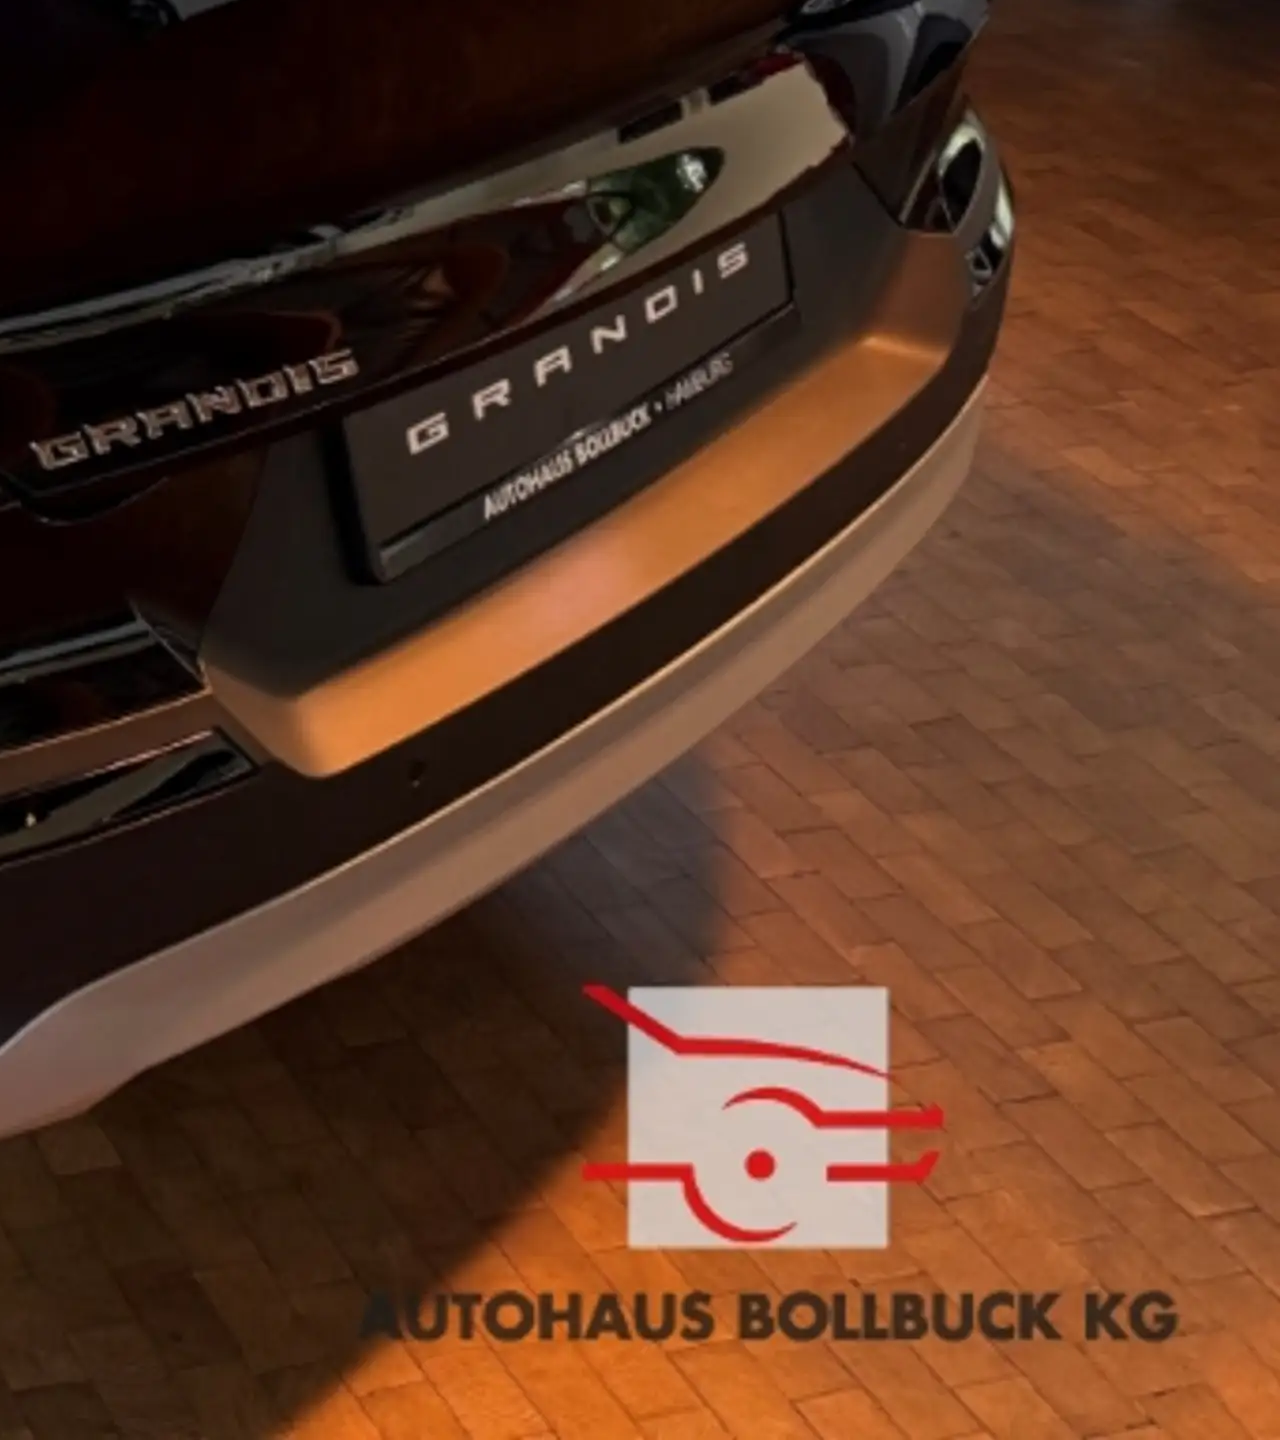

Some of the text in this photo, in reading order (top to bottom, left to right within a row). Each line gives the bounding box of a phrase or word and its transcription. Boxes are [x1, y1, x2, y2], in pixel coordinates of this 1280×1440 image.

[28, 348, 360, 471] GRANDIS
[406, 242, 749, 456] GRANDIS
[483, 447, 574, 521] AUTOHAUS
[573, 402, 653, 468] BOLLBUCK
